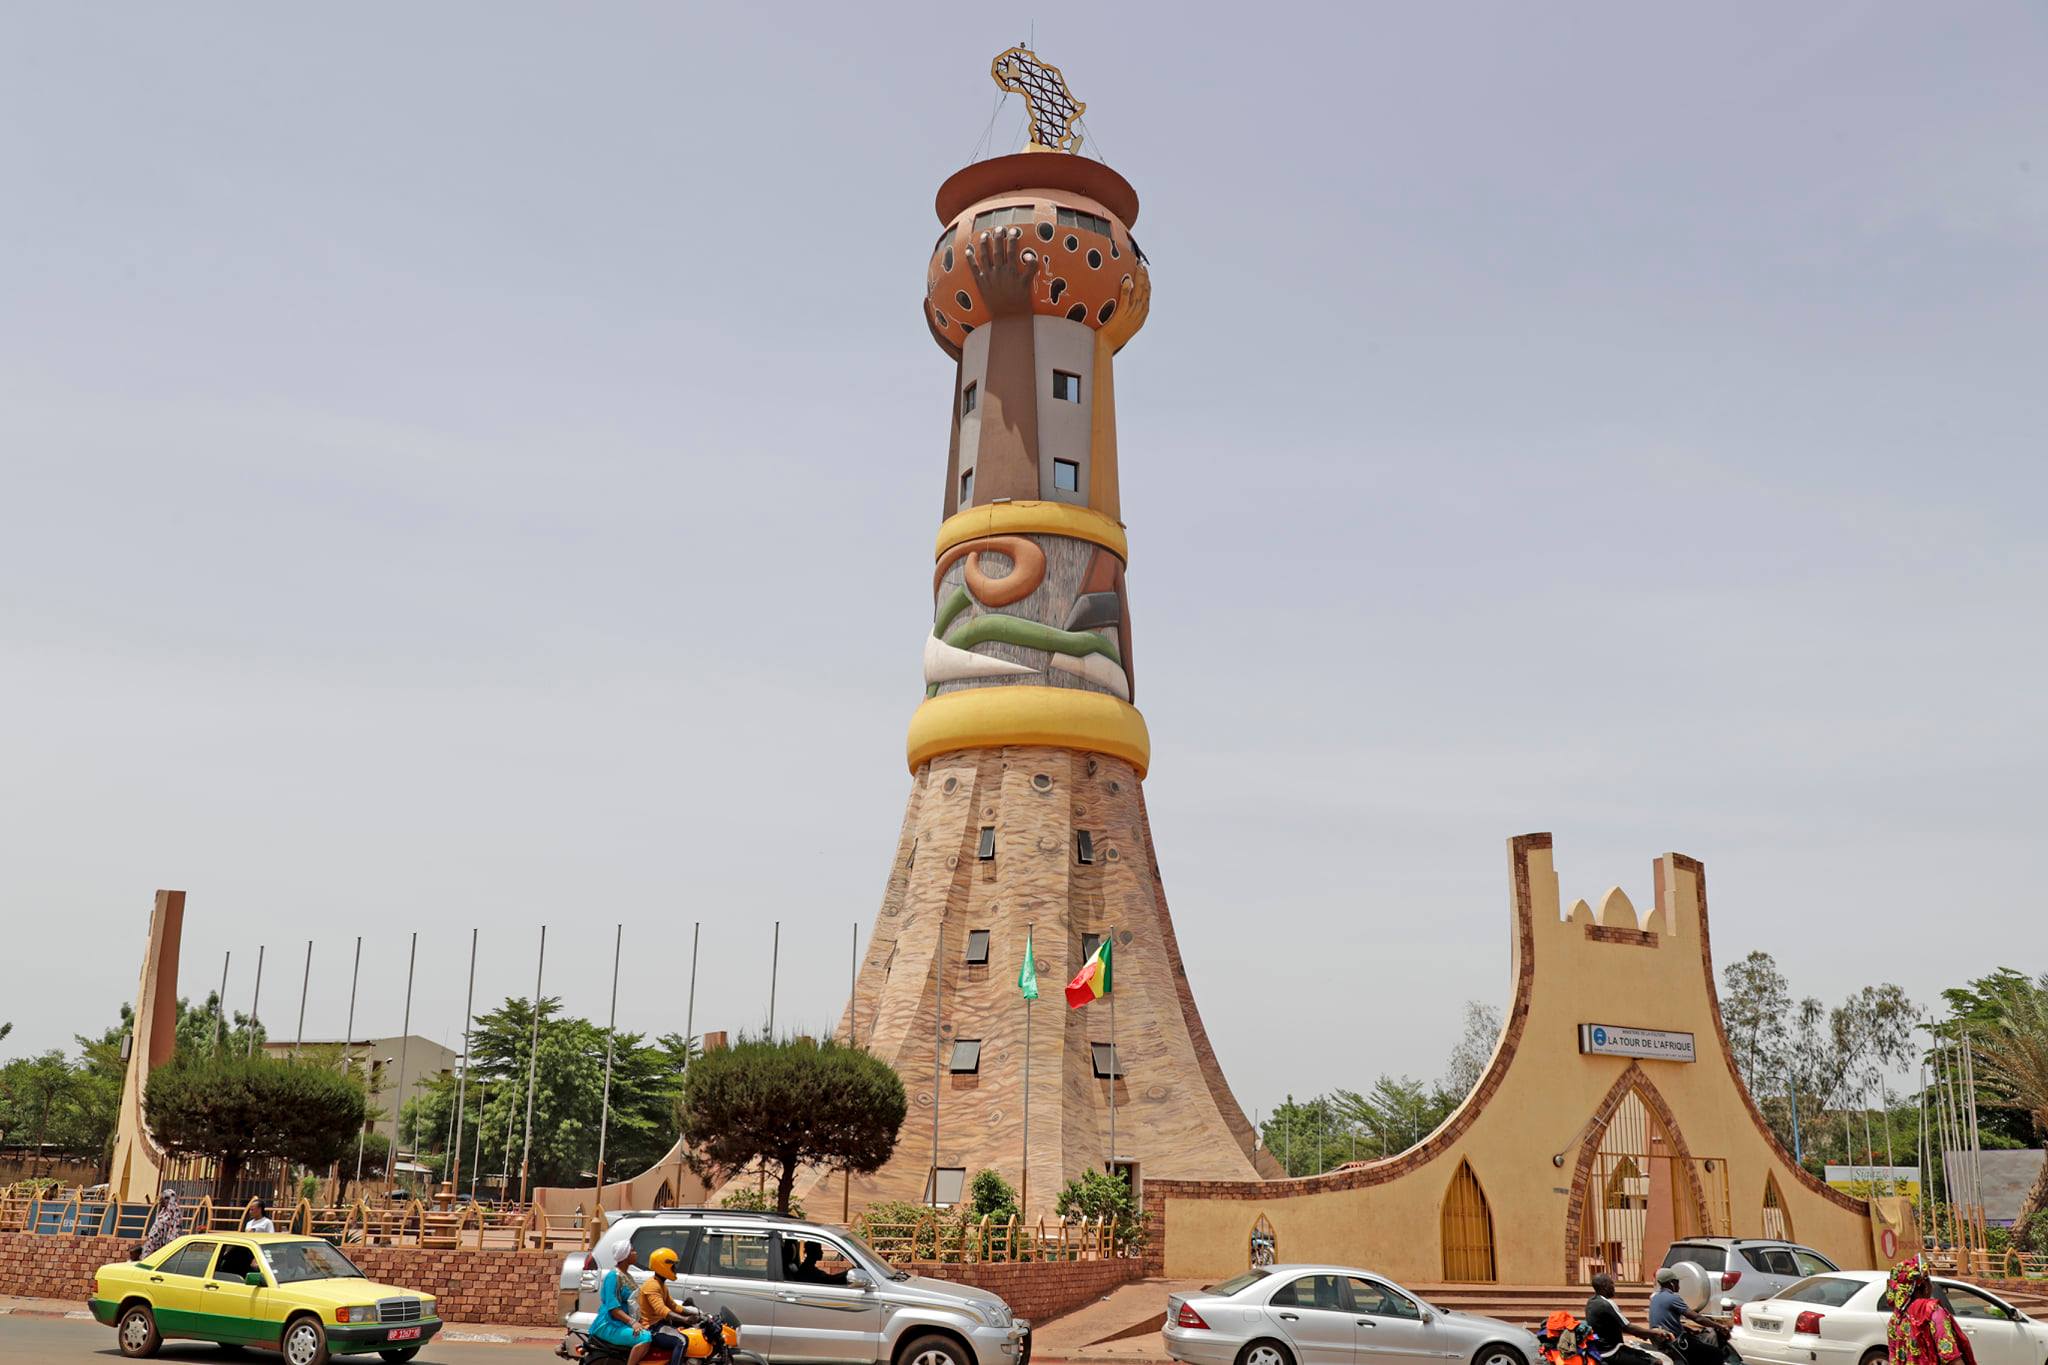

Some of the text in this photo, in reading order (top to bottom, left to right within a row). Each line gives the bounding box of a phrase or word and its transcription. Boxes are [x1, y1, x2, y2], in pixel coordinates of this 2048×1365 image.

[1608, 1036, 1692, 1051] LA TOUR DE L'AFRIQUE
